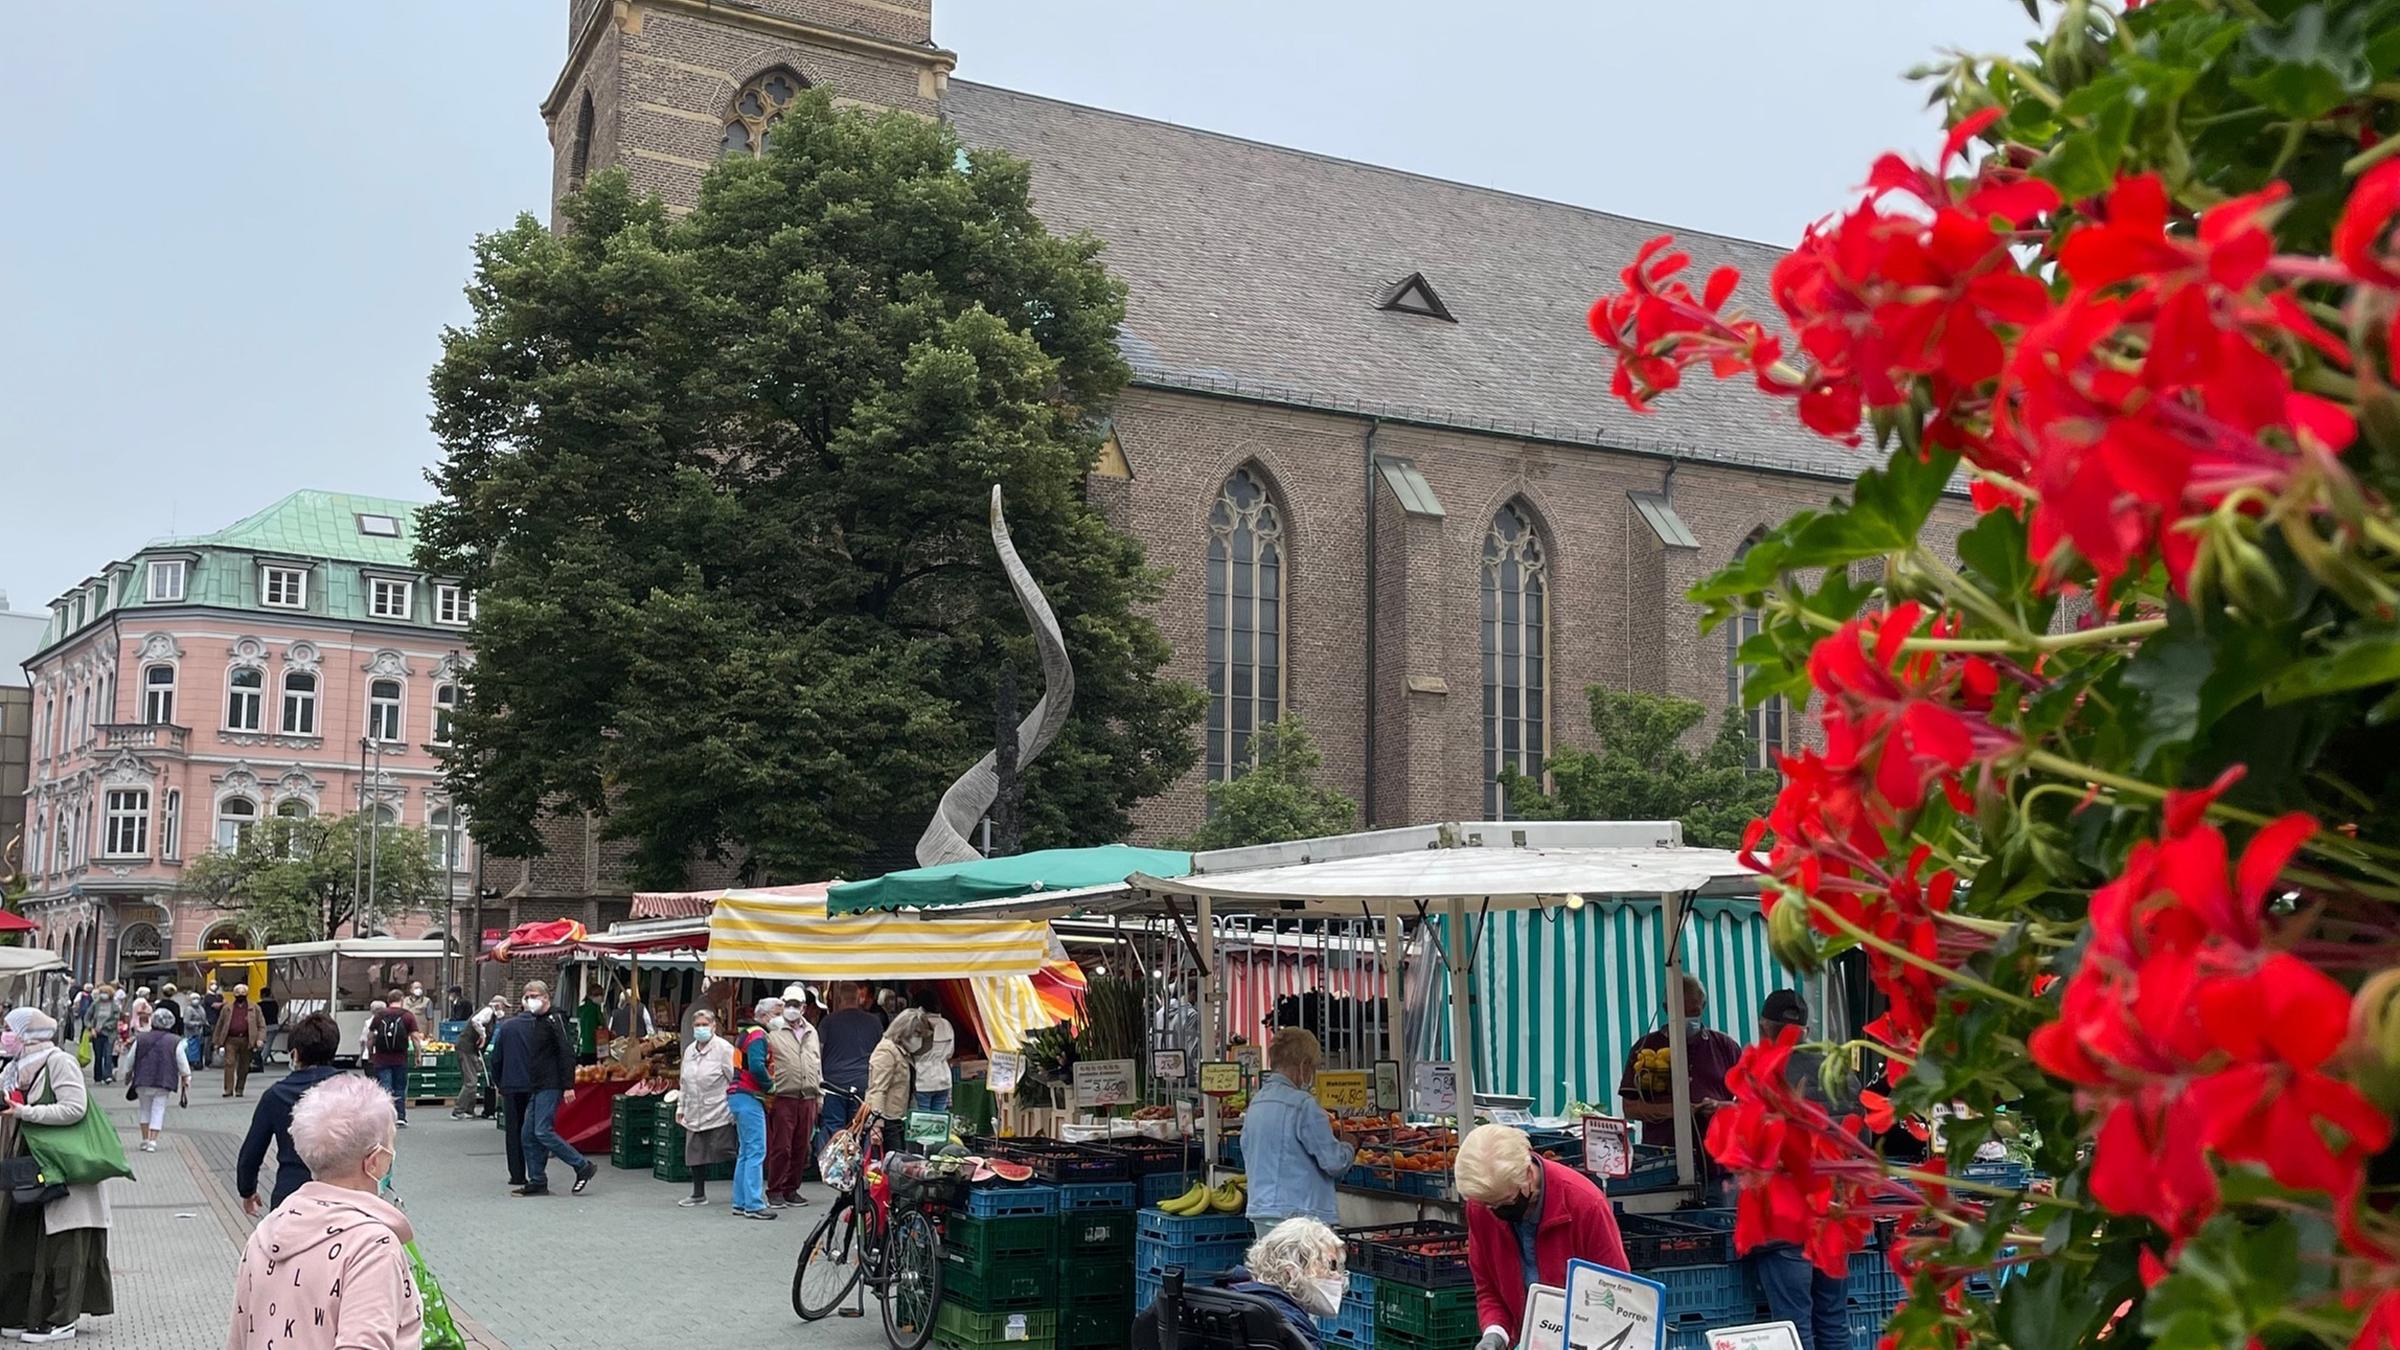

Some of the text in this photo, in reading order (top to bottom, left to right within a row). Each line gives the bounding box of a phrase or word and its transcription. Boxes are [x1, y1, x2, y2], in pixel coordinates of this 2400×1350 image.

[330, 1278, 341, 1298] A
[314, 1307, 325, 1327] W
[1616, 1306, 1648, 1323] Porree
[284, 1318, 296, 1338] K
[1539, 1319, 1564, 1334] Sup
